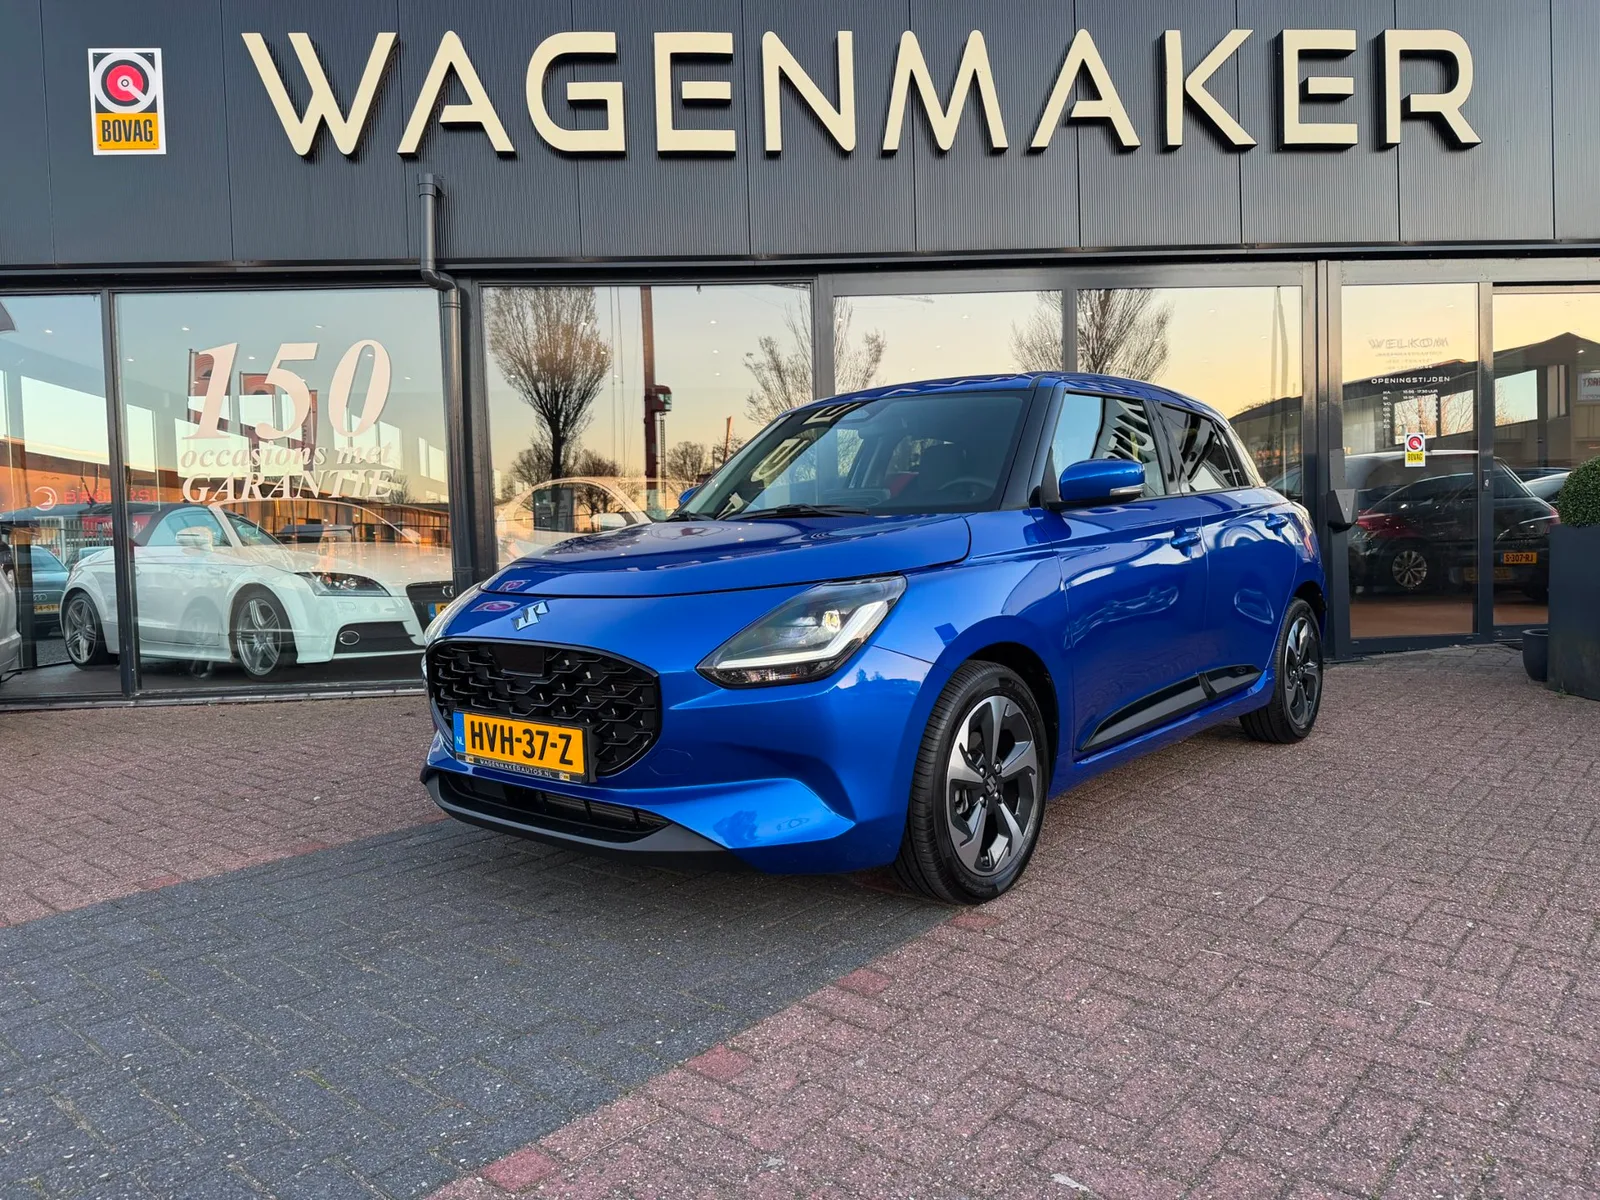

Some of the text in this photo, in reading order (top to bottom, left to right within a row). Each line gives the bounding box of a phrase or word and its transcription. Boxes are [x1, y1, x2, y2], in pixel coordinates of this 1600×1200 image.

[241, 28, 1482, 155] WAGENMAKER
[101, 118, 154, 143] BOVAG
[1368, 337, 1449, 349] WELKOM
[182, 339, 392, 440] 150
[1371, 376, 1450, 384] OPENINGSTIJDEN
[180, 440, 392, 468] occasions met
[180, 468, 395, 502] GARANTIE
[1505, 554, 1534, 562] S-307-RJ
[455, 737, 465, 746] NL
[470, 720, 574, 766] HVH-37-Z
